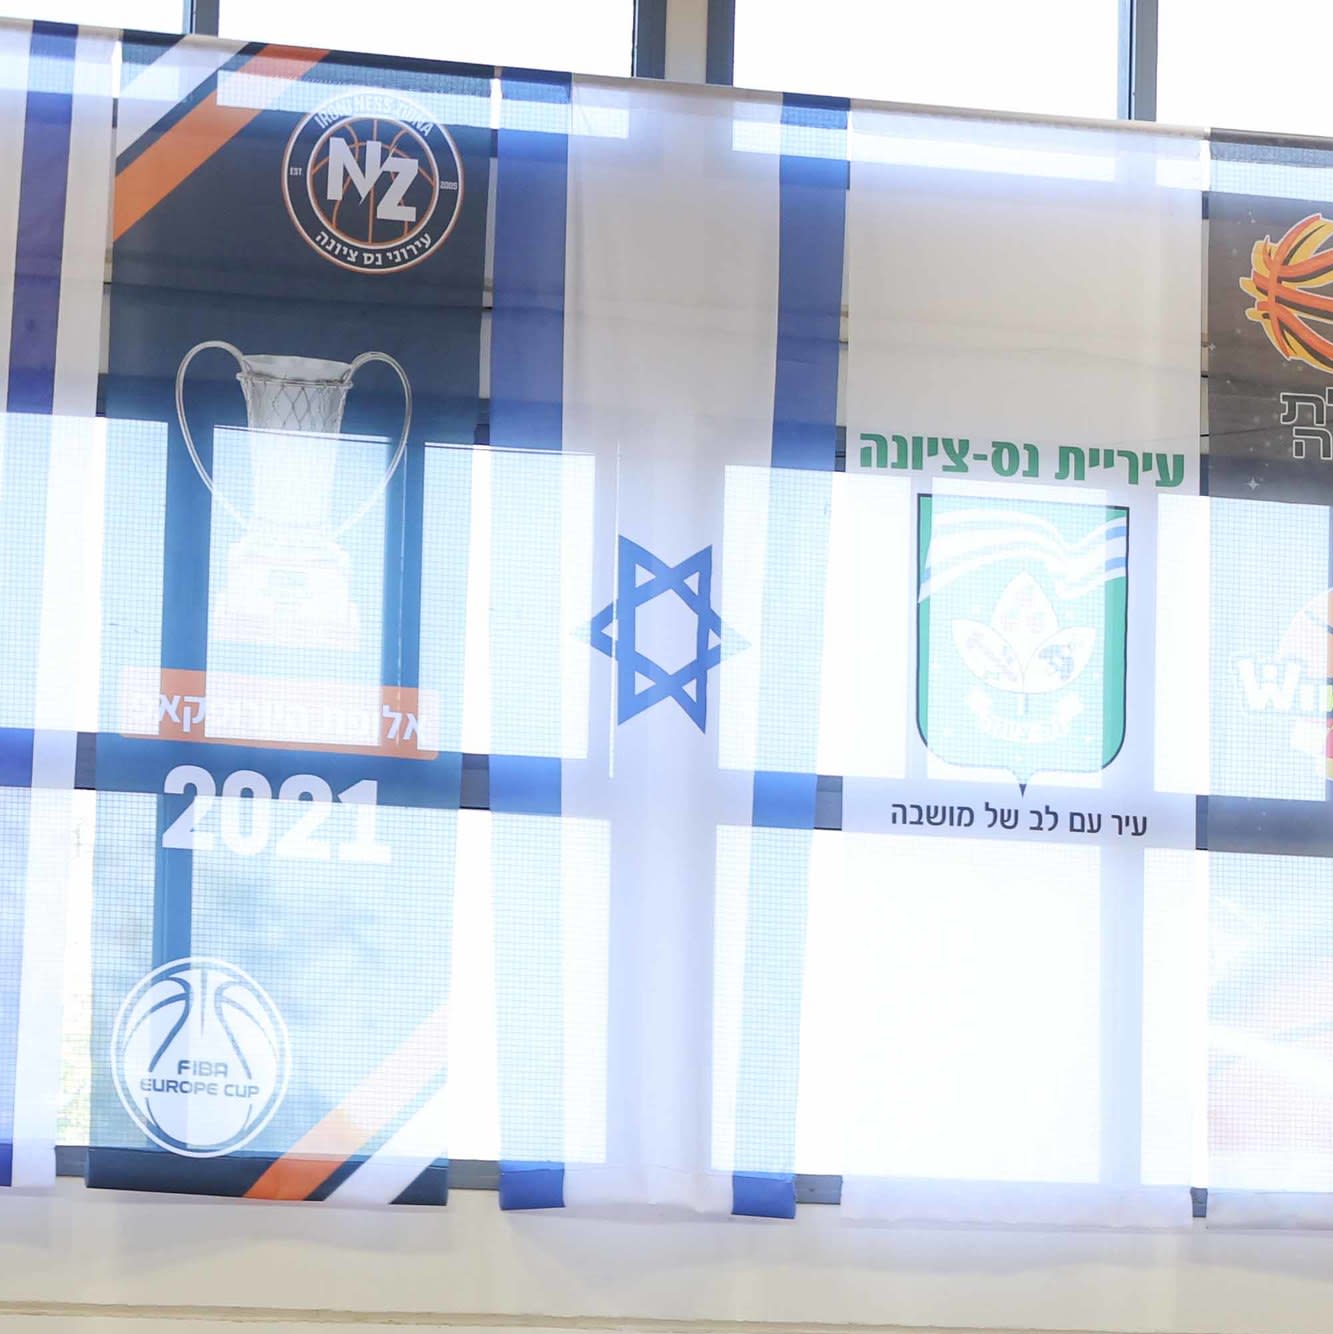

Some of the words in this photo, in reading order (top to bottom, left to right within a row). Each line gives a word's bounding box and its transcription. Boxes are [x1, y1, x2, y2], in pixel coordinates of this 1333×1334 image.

[326, 136, 419, 223] NZ
[314, 230, 358, 264] ציונה
[362, 251, 384, 266] נס
[387, 232, 432, 264] עירוני
[859, 432, 1039, 477] נס-ציונה
[1054, 446, 1185, 488] עיריית
[161, 764, 392, 865] 2021
[891, 803, 975, 828] מושבה
[984, 801, 1019, 830] של
[1029, 805, 1059, 831] לב
[1068, 811, 1102, 834] עם
[1111, 813, 1148, 836] עיר
[177, 1059, 228, 1078] FIBA
[140, 1078, 218, 1096] EUROPE
[223, 1084, 260, 1098] CUP
